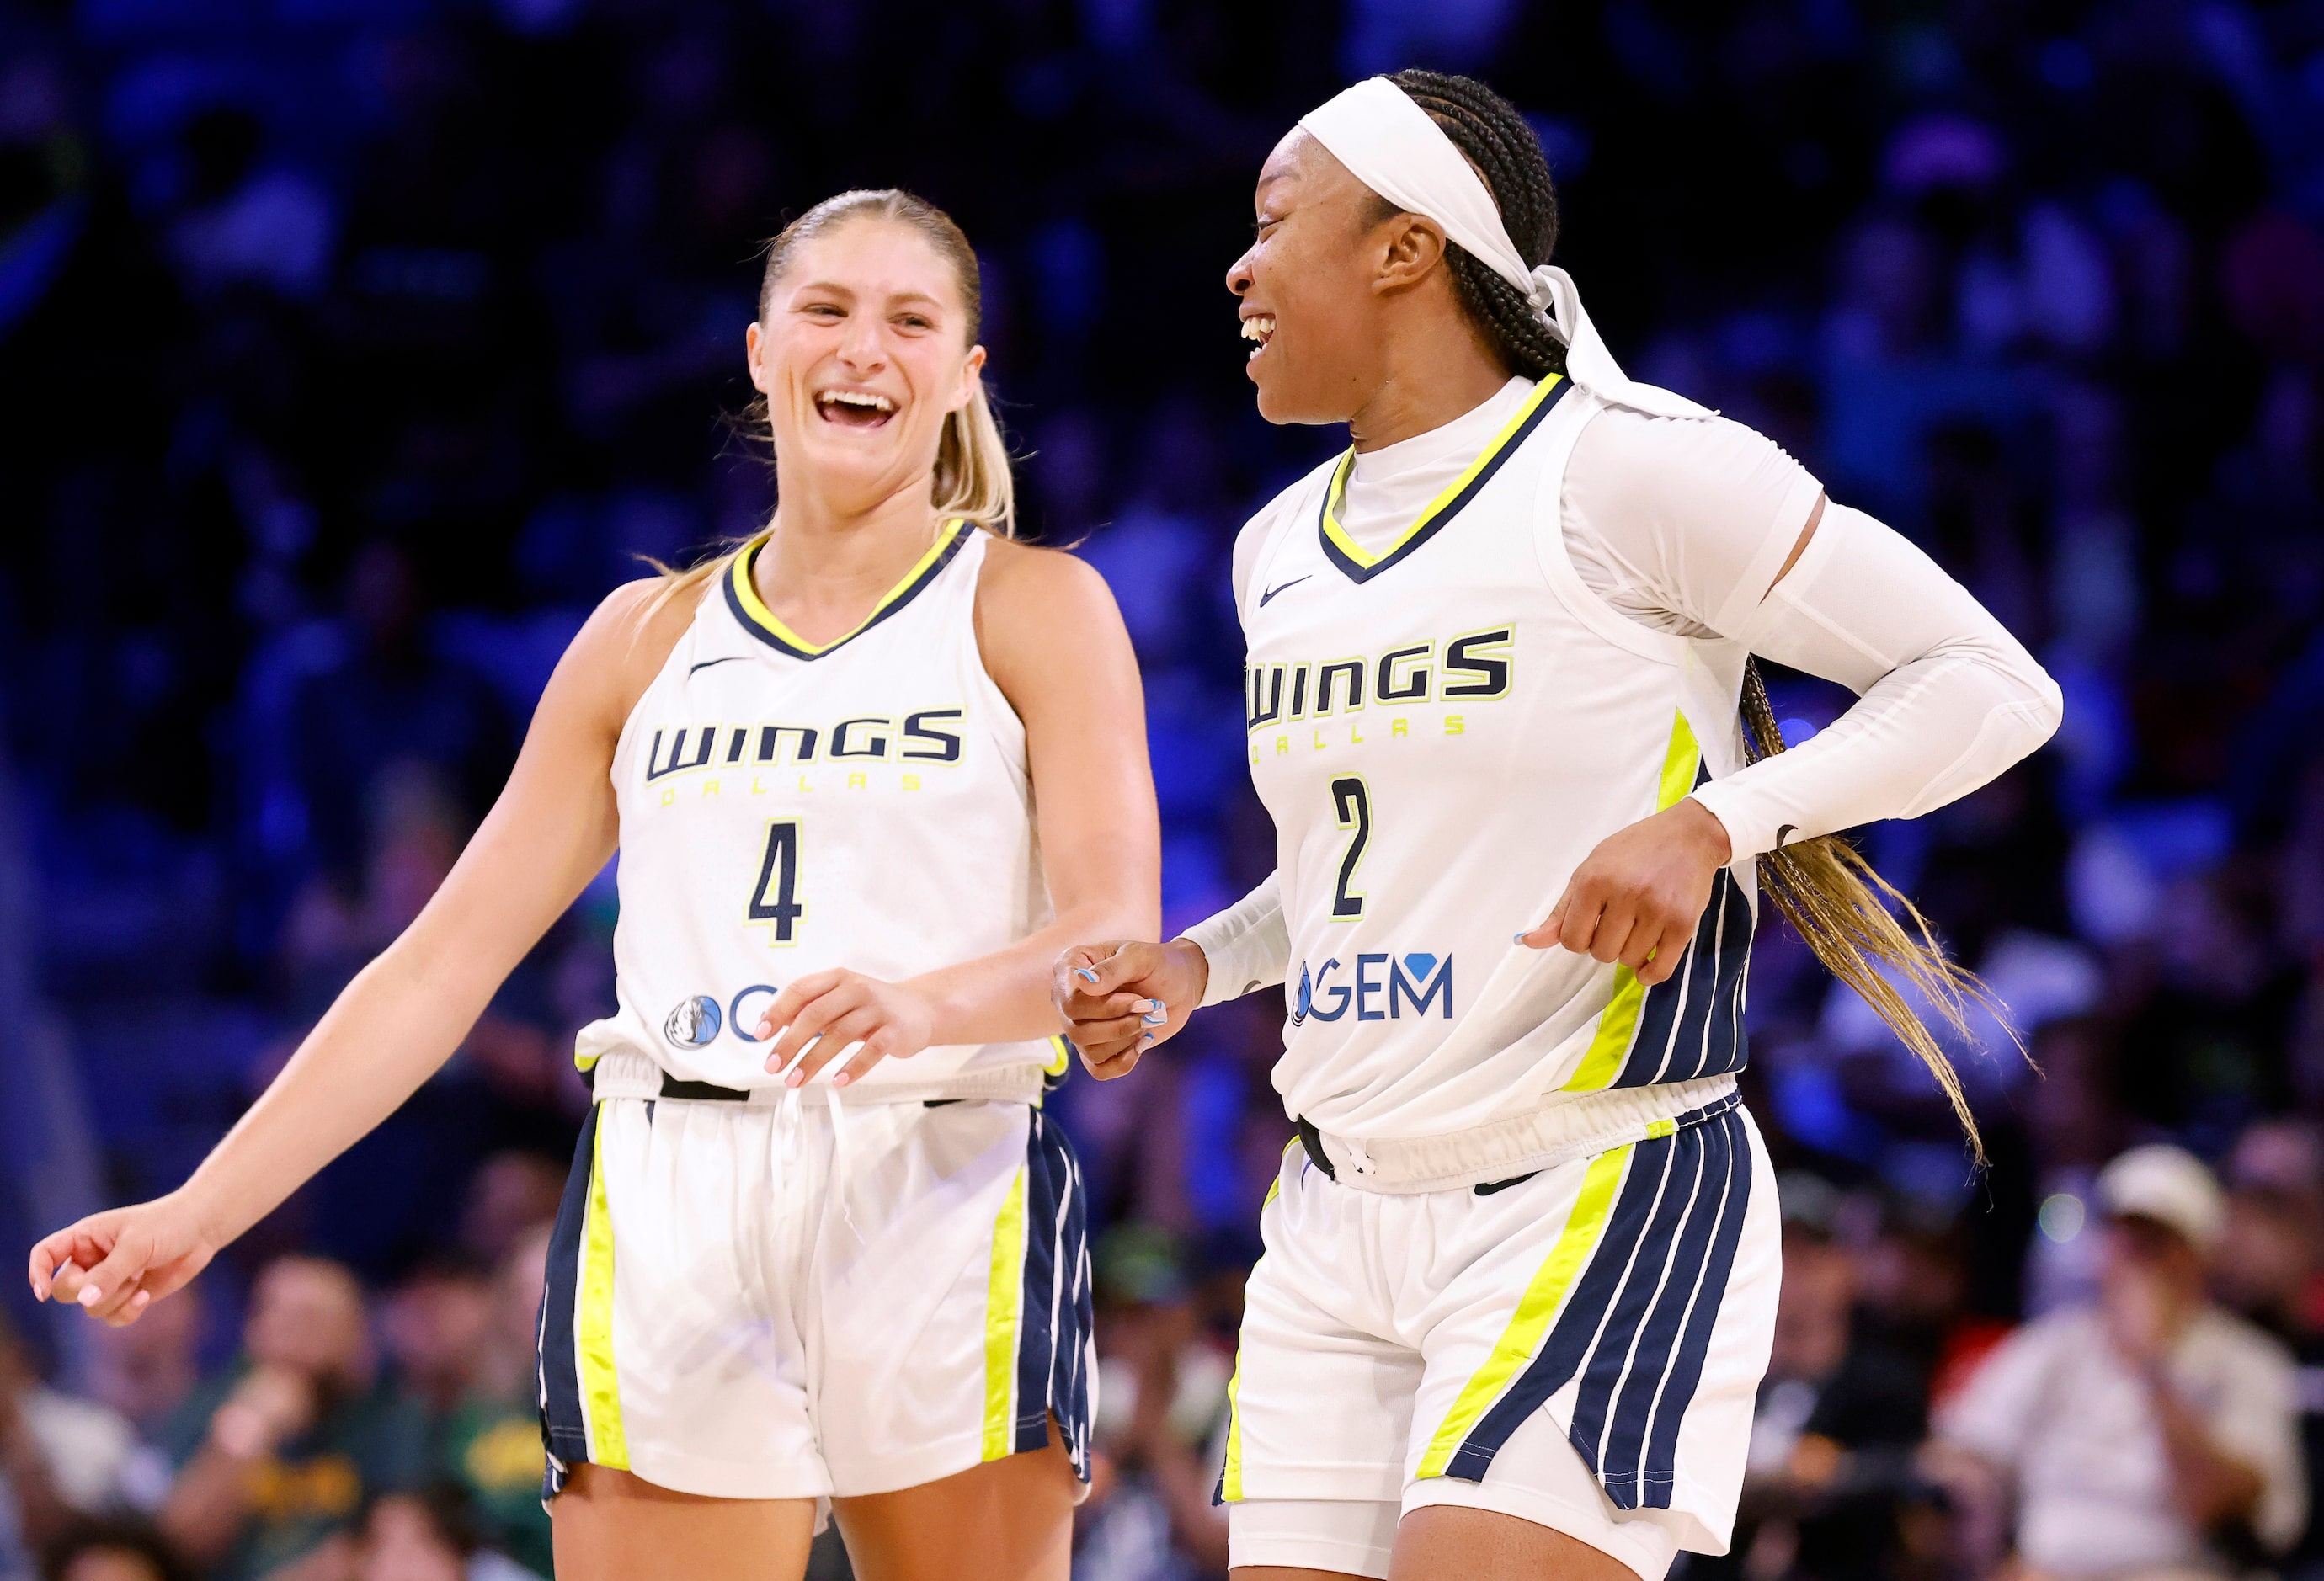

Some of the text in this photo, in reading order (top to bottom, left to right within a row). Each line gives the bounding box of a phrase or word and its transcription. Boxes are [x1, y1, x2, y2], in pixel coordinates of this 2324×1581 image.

[1246, 622, 1516, 737] WINGS
[645, 704, 968, 786] WINGS
[1251, 714, 1464, 764] DALLAS
[660, 773, 922, 806] DALLAS
[742, 816, 808, 948] 4
[1328, 772, 1373, 923] 2
[1309, 952, 1453, 1022] GEM
